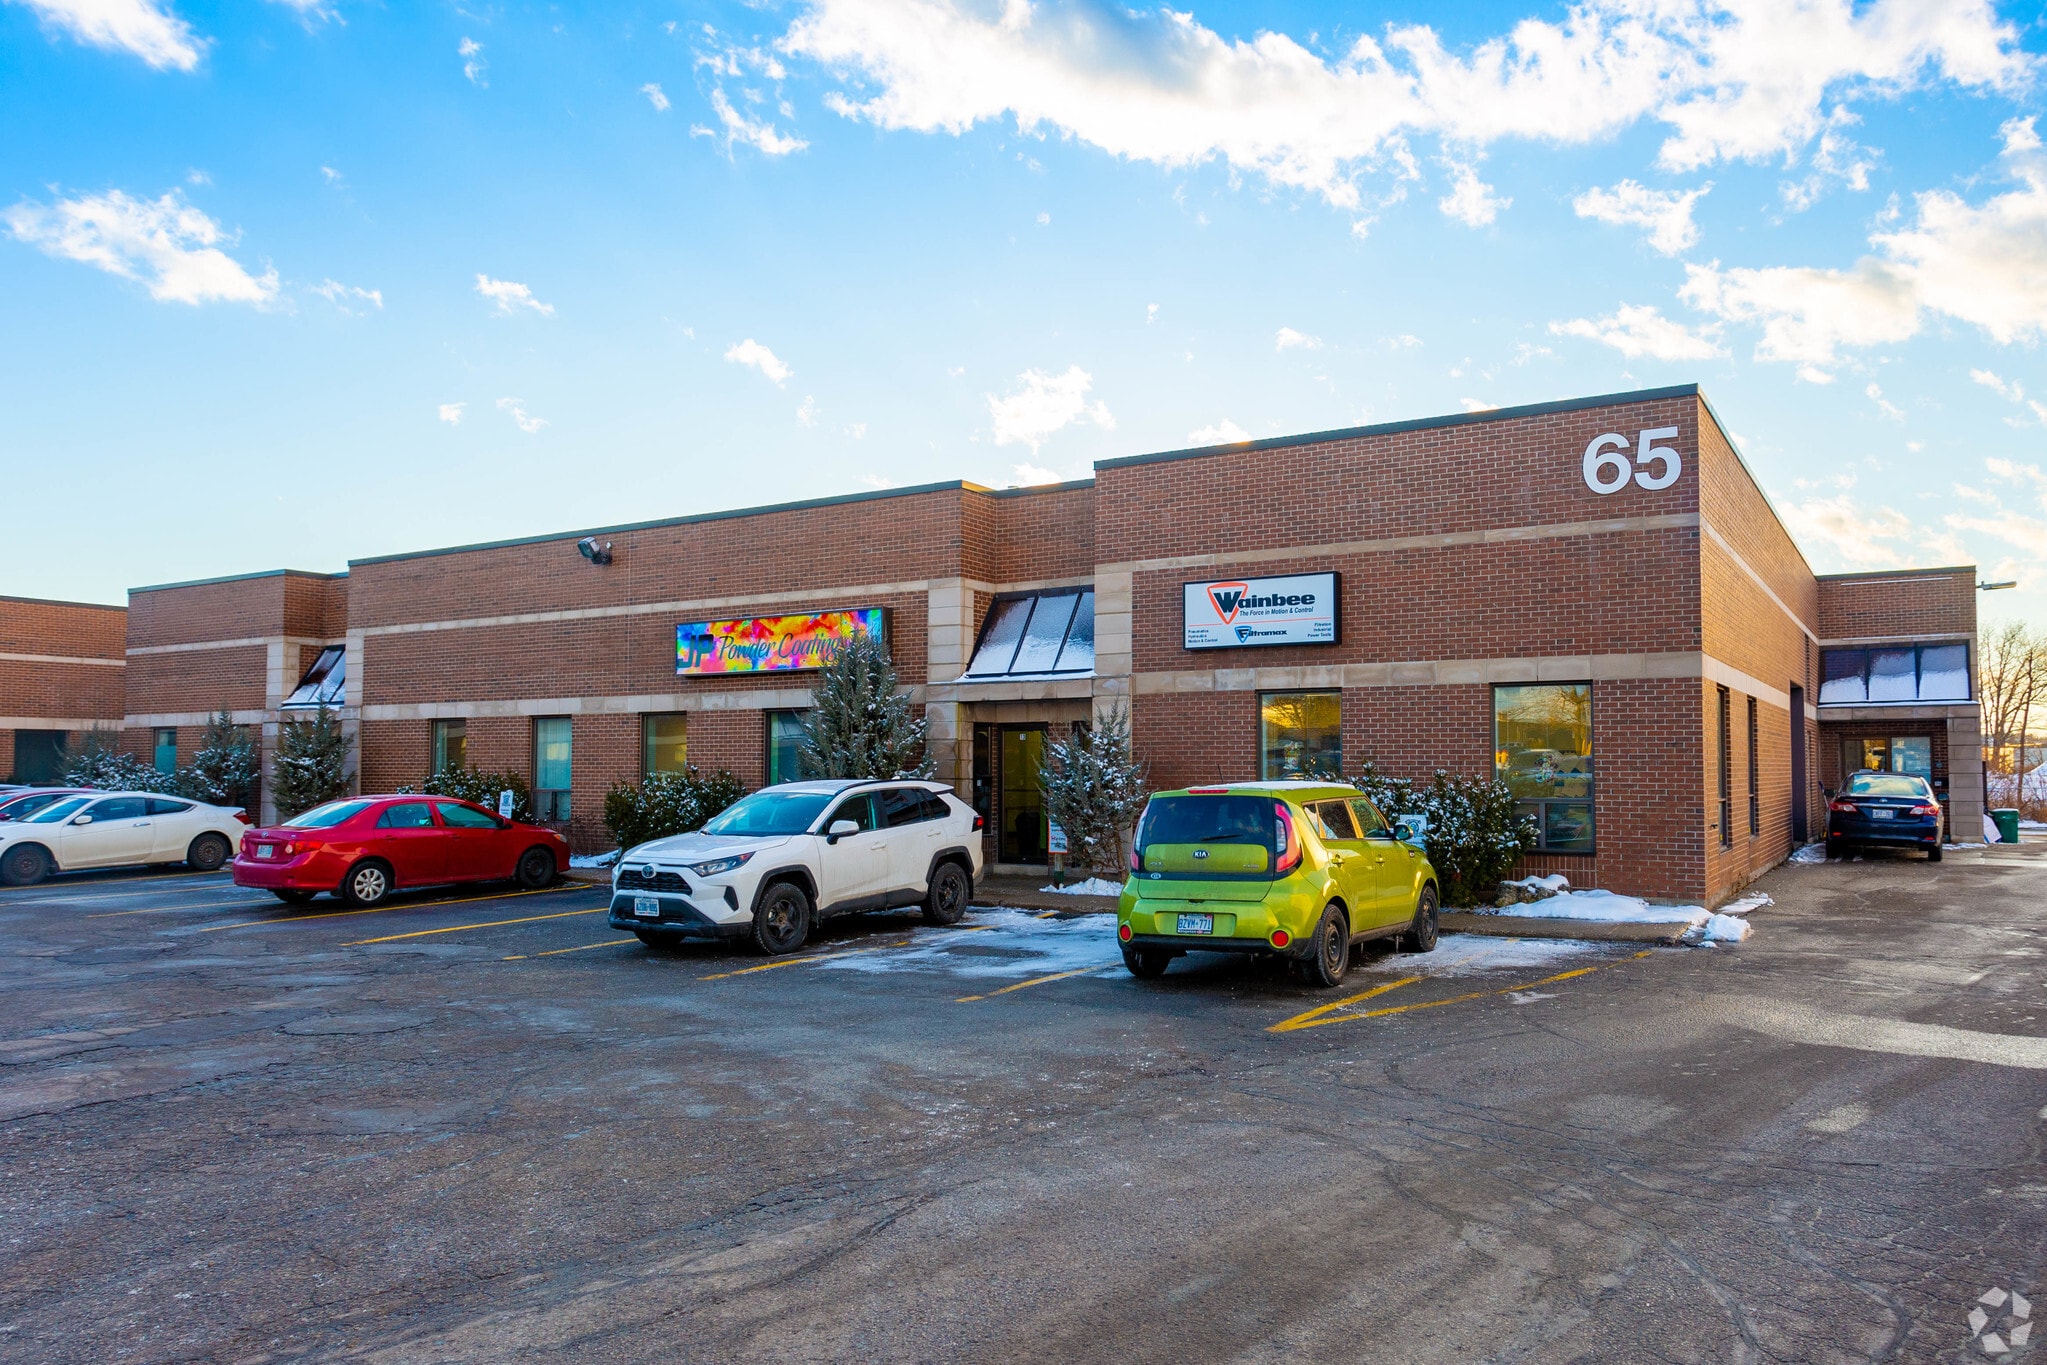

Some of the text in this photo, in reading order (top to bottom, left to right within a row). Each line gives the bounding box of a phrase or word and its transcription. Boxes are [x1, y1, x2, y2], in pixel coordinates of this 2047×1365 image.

[1583, 426, 1681, 494] 65
[1213, 591, 1315, 613] Wainbee
[1237, 628, 1287, 639] Filtramax
[676, 632, 843, 668] JP Powder Coating
